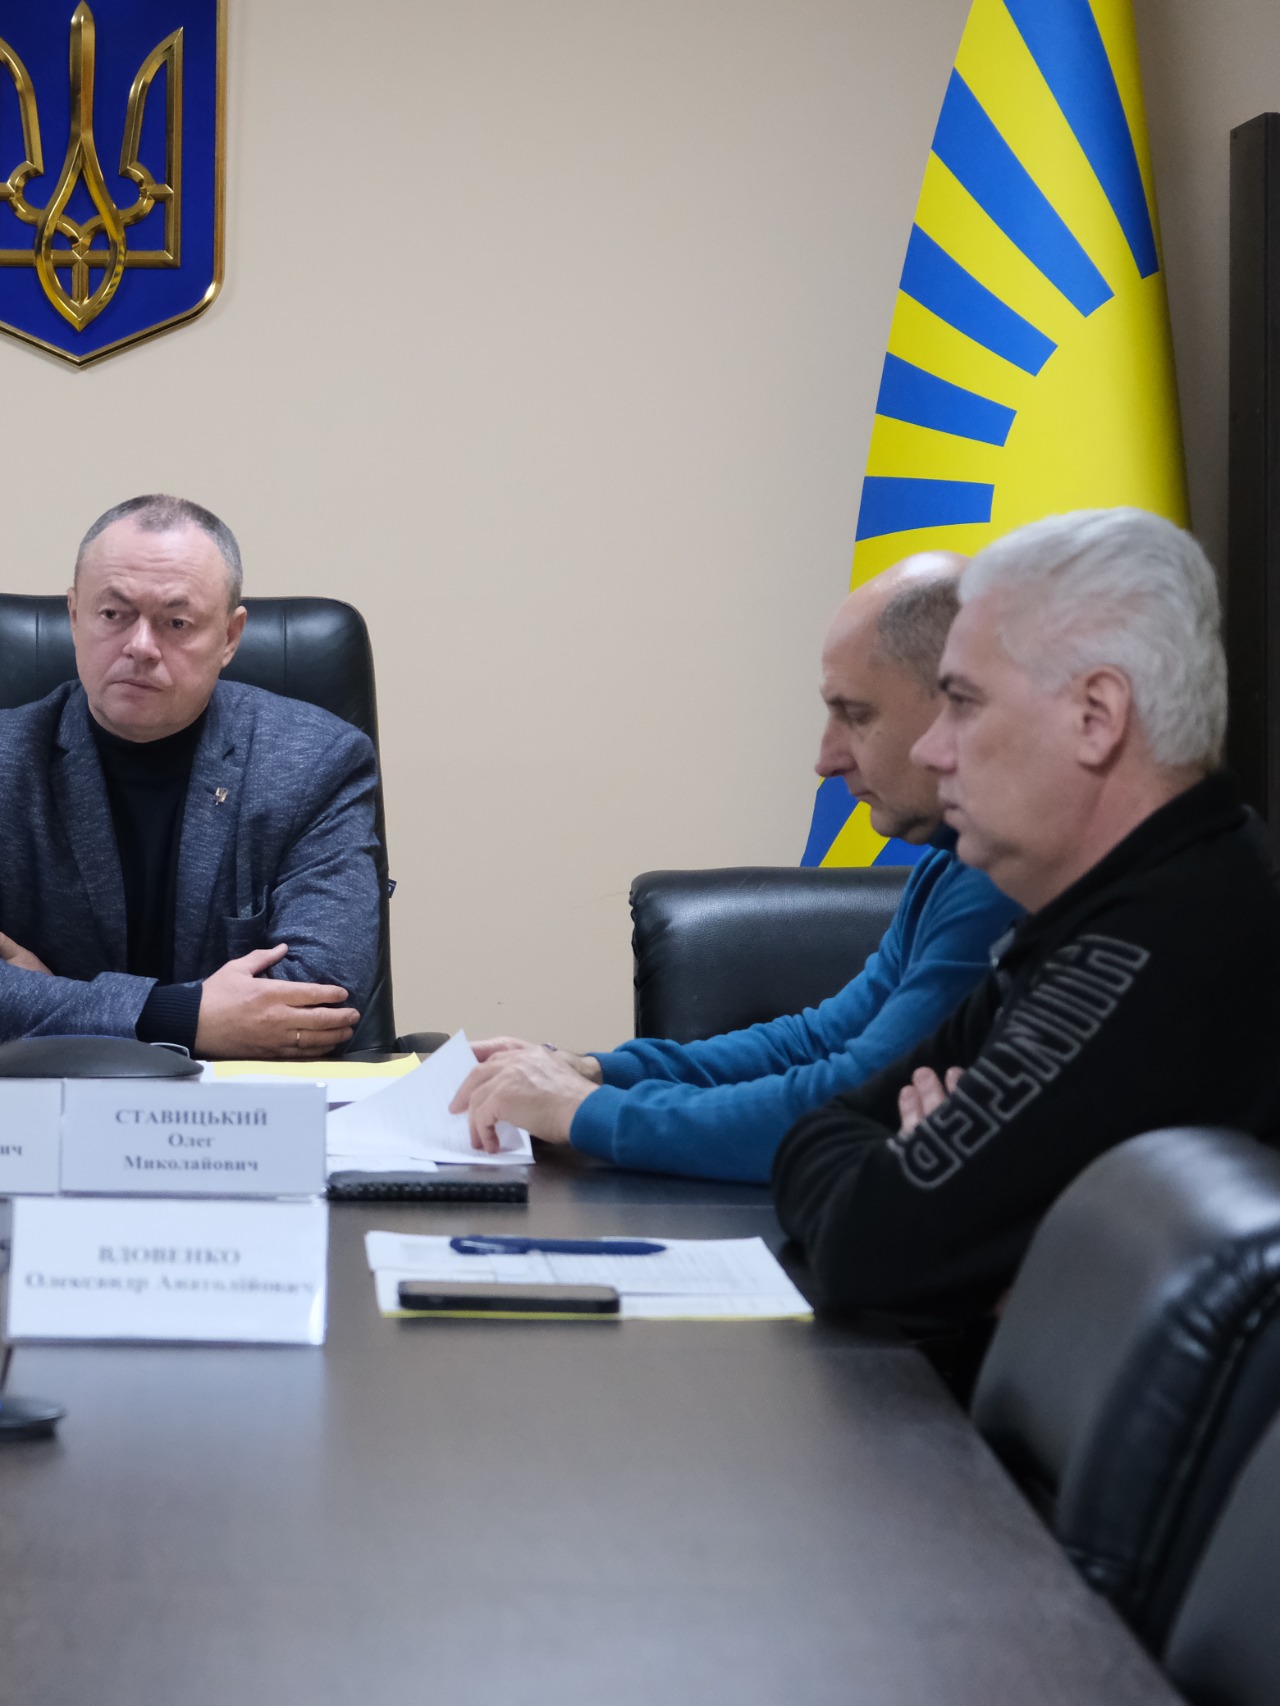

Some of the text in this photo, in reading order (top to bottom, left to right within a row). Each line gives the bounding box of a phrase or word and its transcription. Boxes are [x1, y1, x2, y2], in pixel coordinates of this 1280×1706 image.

[115, 1108, 268, 1127] СТАВИЦЬКИЙ
[168, 1132, 215, 1148] Олег
[124, 1155, 259, 1172] Миколайович
